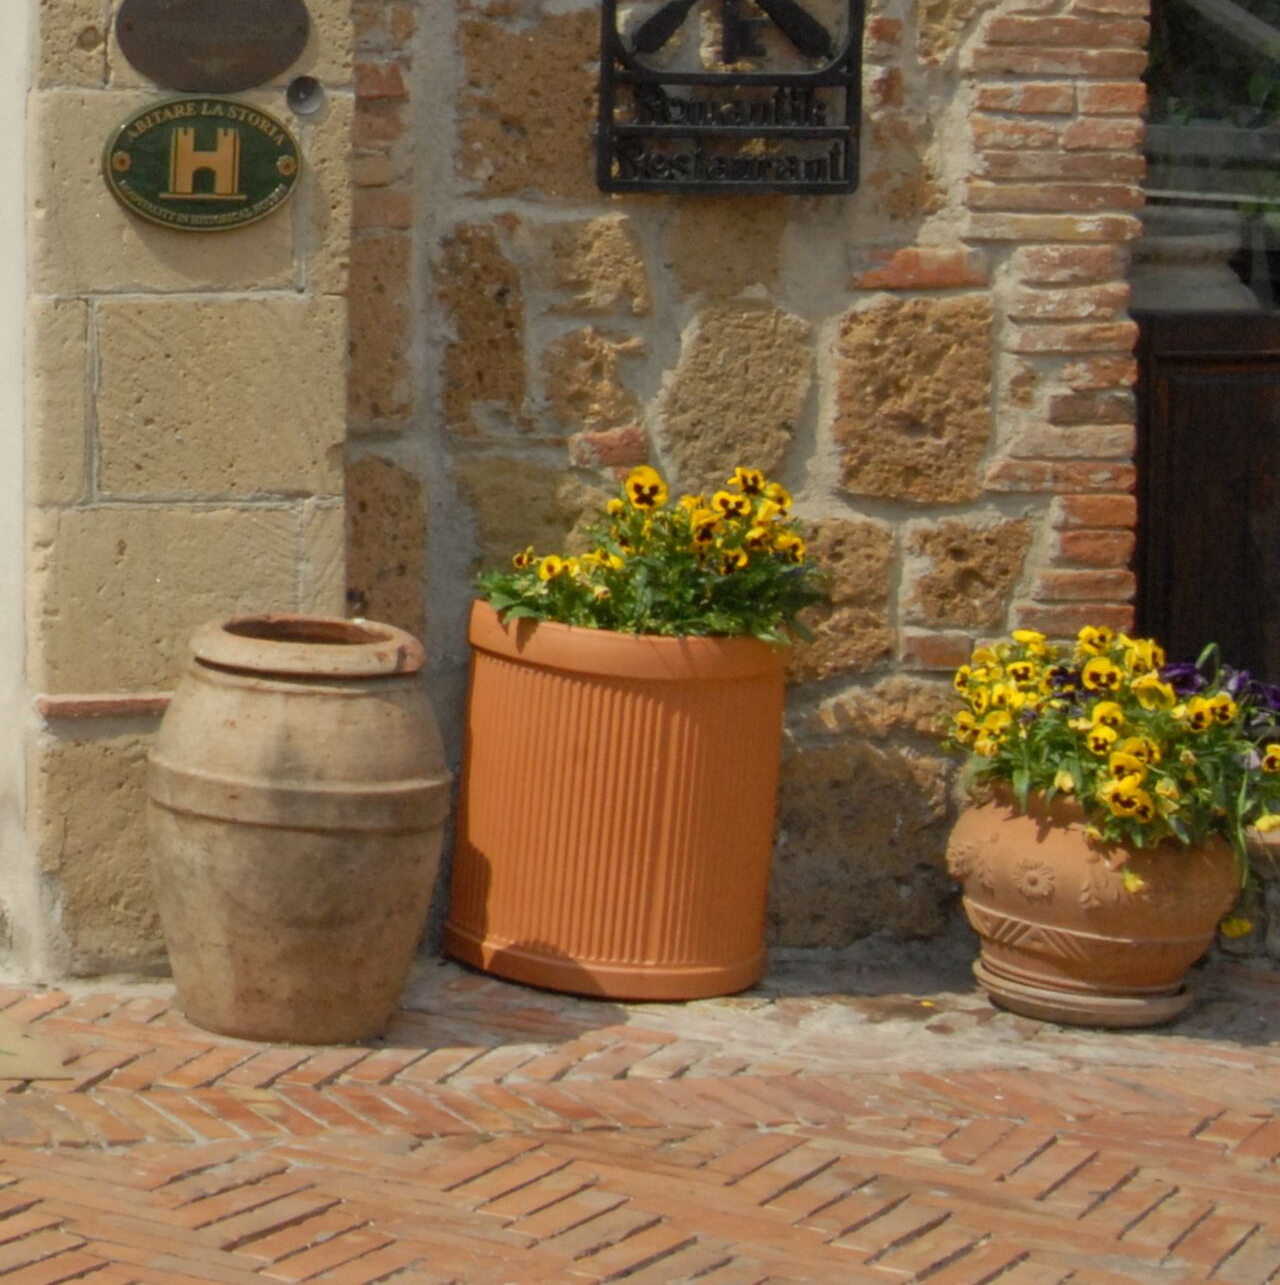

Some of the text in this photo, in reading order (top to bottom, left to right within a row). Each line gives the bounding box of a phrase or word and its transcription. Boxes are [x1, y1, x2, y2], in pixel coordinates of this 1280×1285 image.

[126, 102, 286, 147] ABITARE LA STORIA
[614, 134, 846, 182] Restaurant
